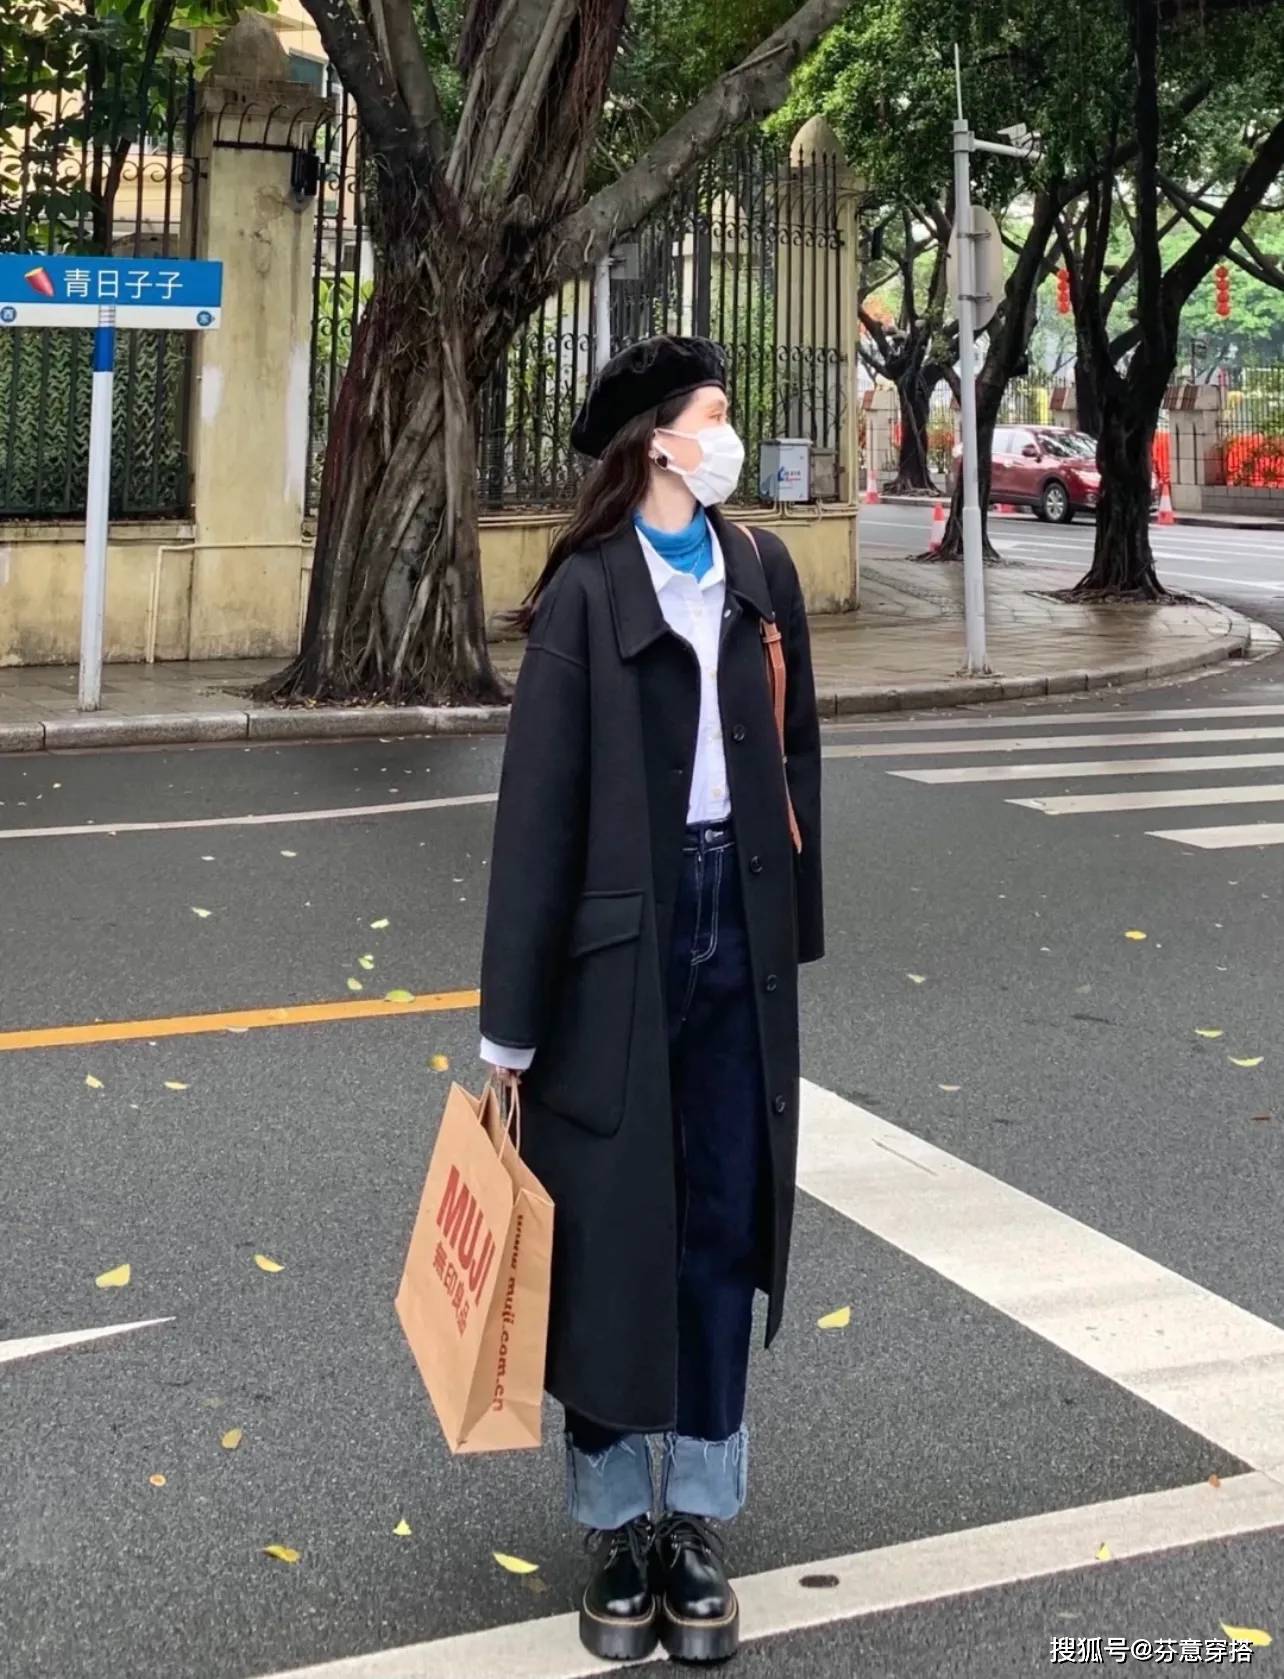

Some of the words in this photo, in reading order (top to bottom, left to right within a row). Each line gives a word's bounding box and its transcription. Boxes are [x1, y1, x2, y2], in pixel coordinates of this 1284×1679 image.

[63, 268, 183, 300] 青日子子
[436, 1164, 496, 1307] MUJI
[493, 1214, 525, 1411] wwwmuji.com.cn
